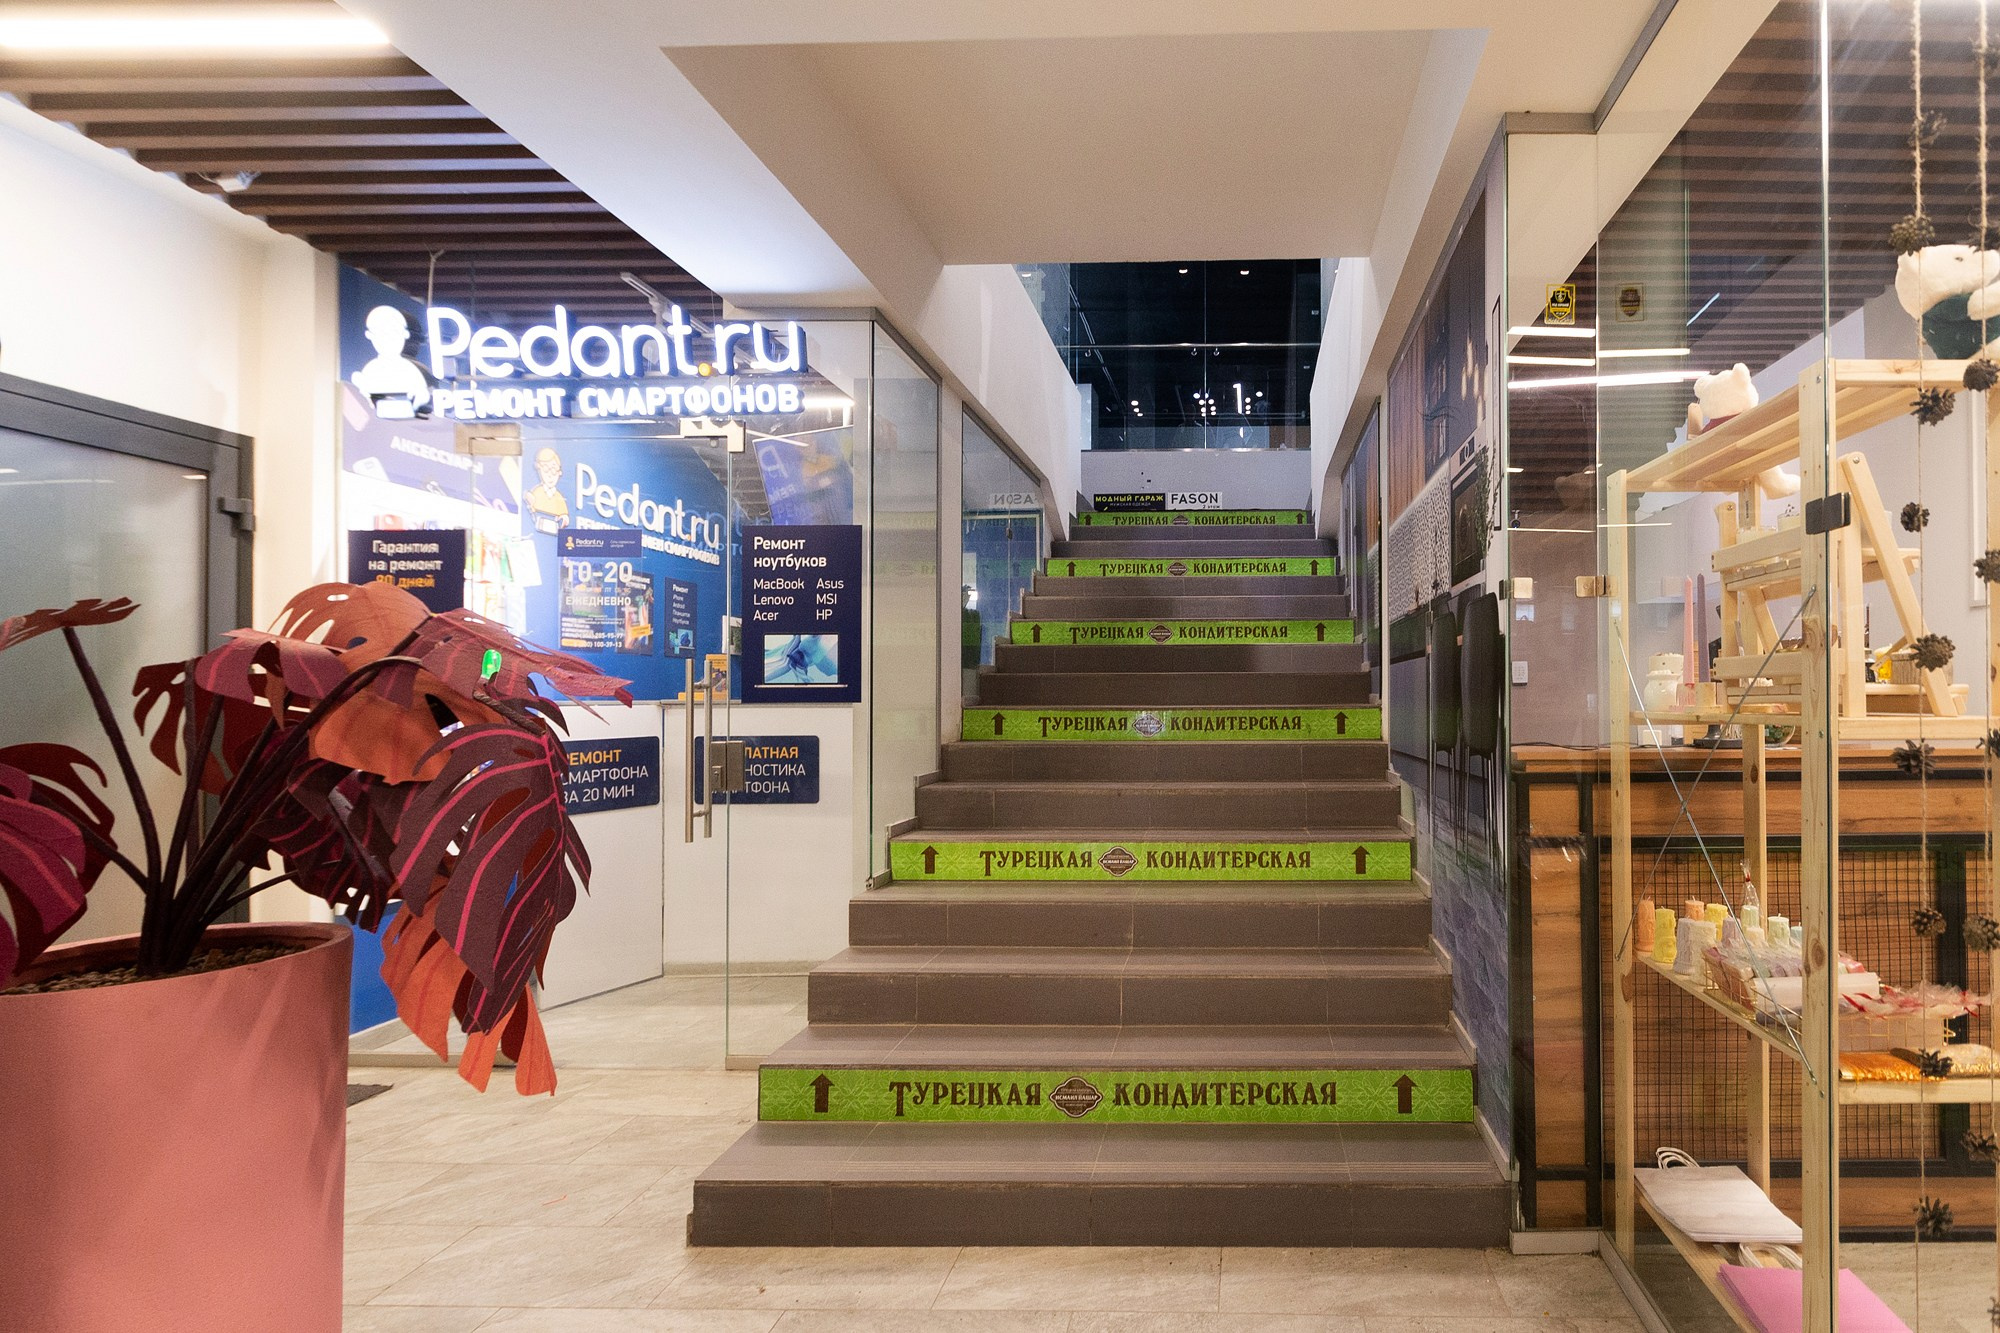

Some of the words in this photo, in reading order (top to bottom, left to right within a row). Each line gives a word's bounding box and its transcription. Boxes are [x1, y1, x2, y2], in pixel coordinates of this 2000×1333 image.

[426, 304, 800, 380] Pedant.ru
[432, 387, 566, 419] РЕМОНТ
[578, 383, 800, 417] СМАРТФОНОВ
[1095, 494, 1133, 502] МОДНЫЙ
[1134, 494, 1164, 502] ГАРАЖ
[1170, 493, 1219, 504] FASON
[575, 463, 720, 549] Pedant.ru
[1113, 516, 1168, 526] ТУРЕЦКАЯ
[1194, 515, 1276, 525] КОНДИТЕРСКАЯ
[372, 540, 439, 556] Гарантия
[753, 536, 805, 550] Ремонт
[368, 560, 387, 570] на
[389, 560, 444, 573] ремонт
[754, 553, 827, 571] ноутбуков
[1100, 563, 1163, 577] ТУРЕЦКАЯ
[1193, 562, 1287, 574] КОНДИТЕРСКАЯ
[398, 574, 435, 589] дней
[753, 578, 805, 591] MacBook
[816, 578, 844, 589] Asus
[566, 596, 632, 607] ЕЖЕДНЕВНО
[753, 594, 794, 605] Lenovo
[816, 593, 837, 605] MSI
[753, 609, 779, 621] Acer
[816, 609, 833, 620] HP
[1069, 626, 1144, 644] ТУРЕЦКАЯ
[1179, 625, 1288, 639] КОНДИТЕРСКАЯ
[1038, 716, 1128, 737] ТУРЕЦКАЯ
[1170, 715, 1301, 731] КОНДИТЕРСКАЯ
[566, 749, 622, 766] ЕМОНТ
[745, 746, 799, 759] ЛАТНАЯ
[745, 763, 806, 777] НОСТИКА
[582, 788, 600, 802] 20
[603, 784, 635, 800] МИН
[979, 851, 1092, 876] ТУРЕЦКАЯ
[1146, 850, 1312, 870] КОНДИТЕРСКАЯ
[889, 1081, 1042, 1117] ТУРЕЦКАЯ
[1112, 1081, 1338, 1109] КОНДИТЕРСКАЯ
